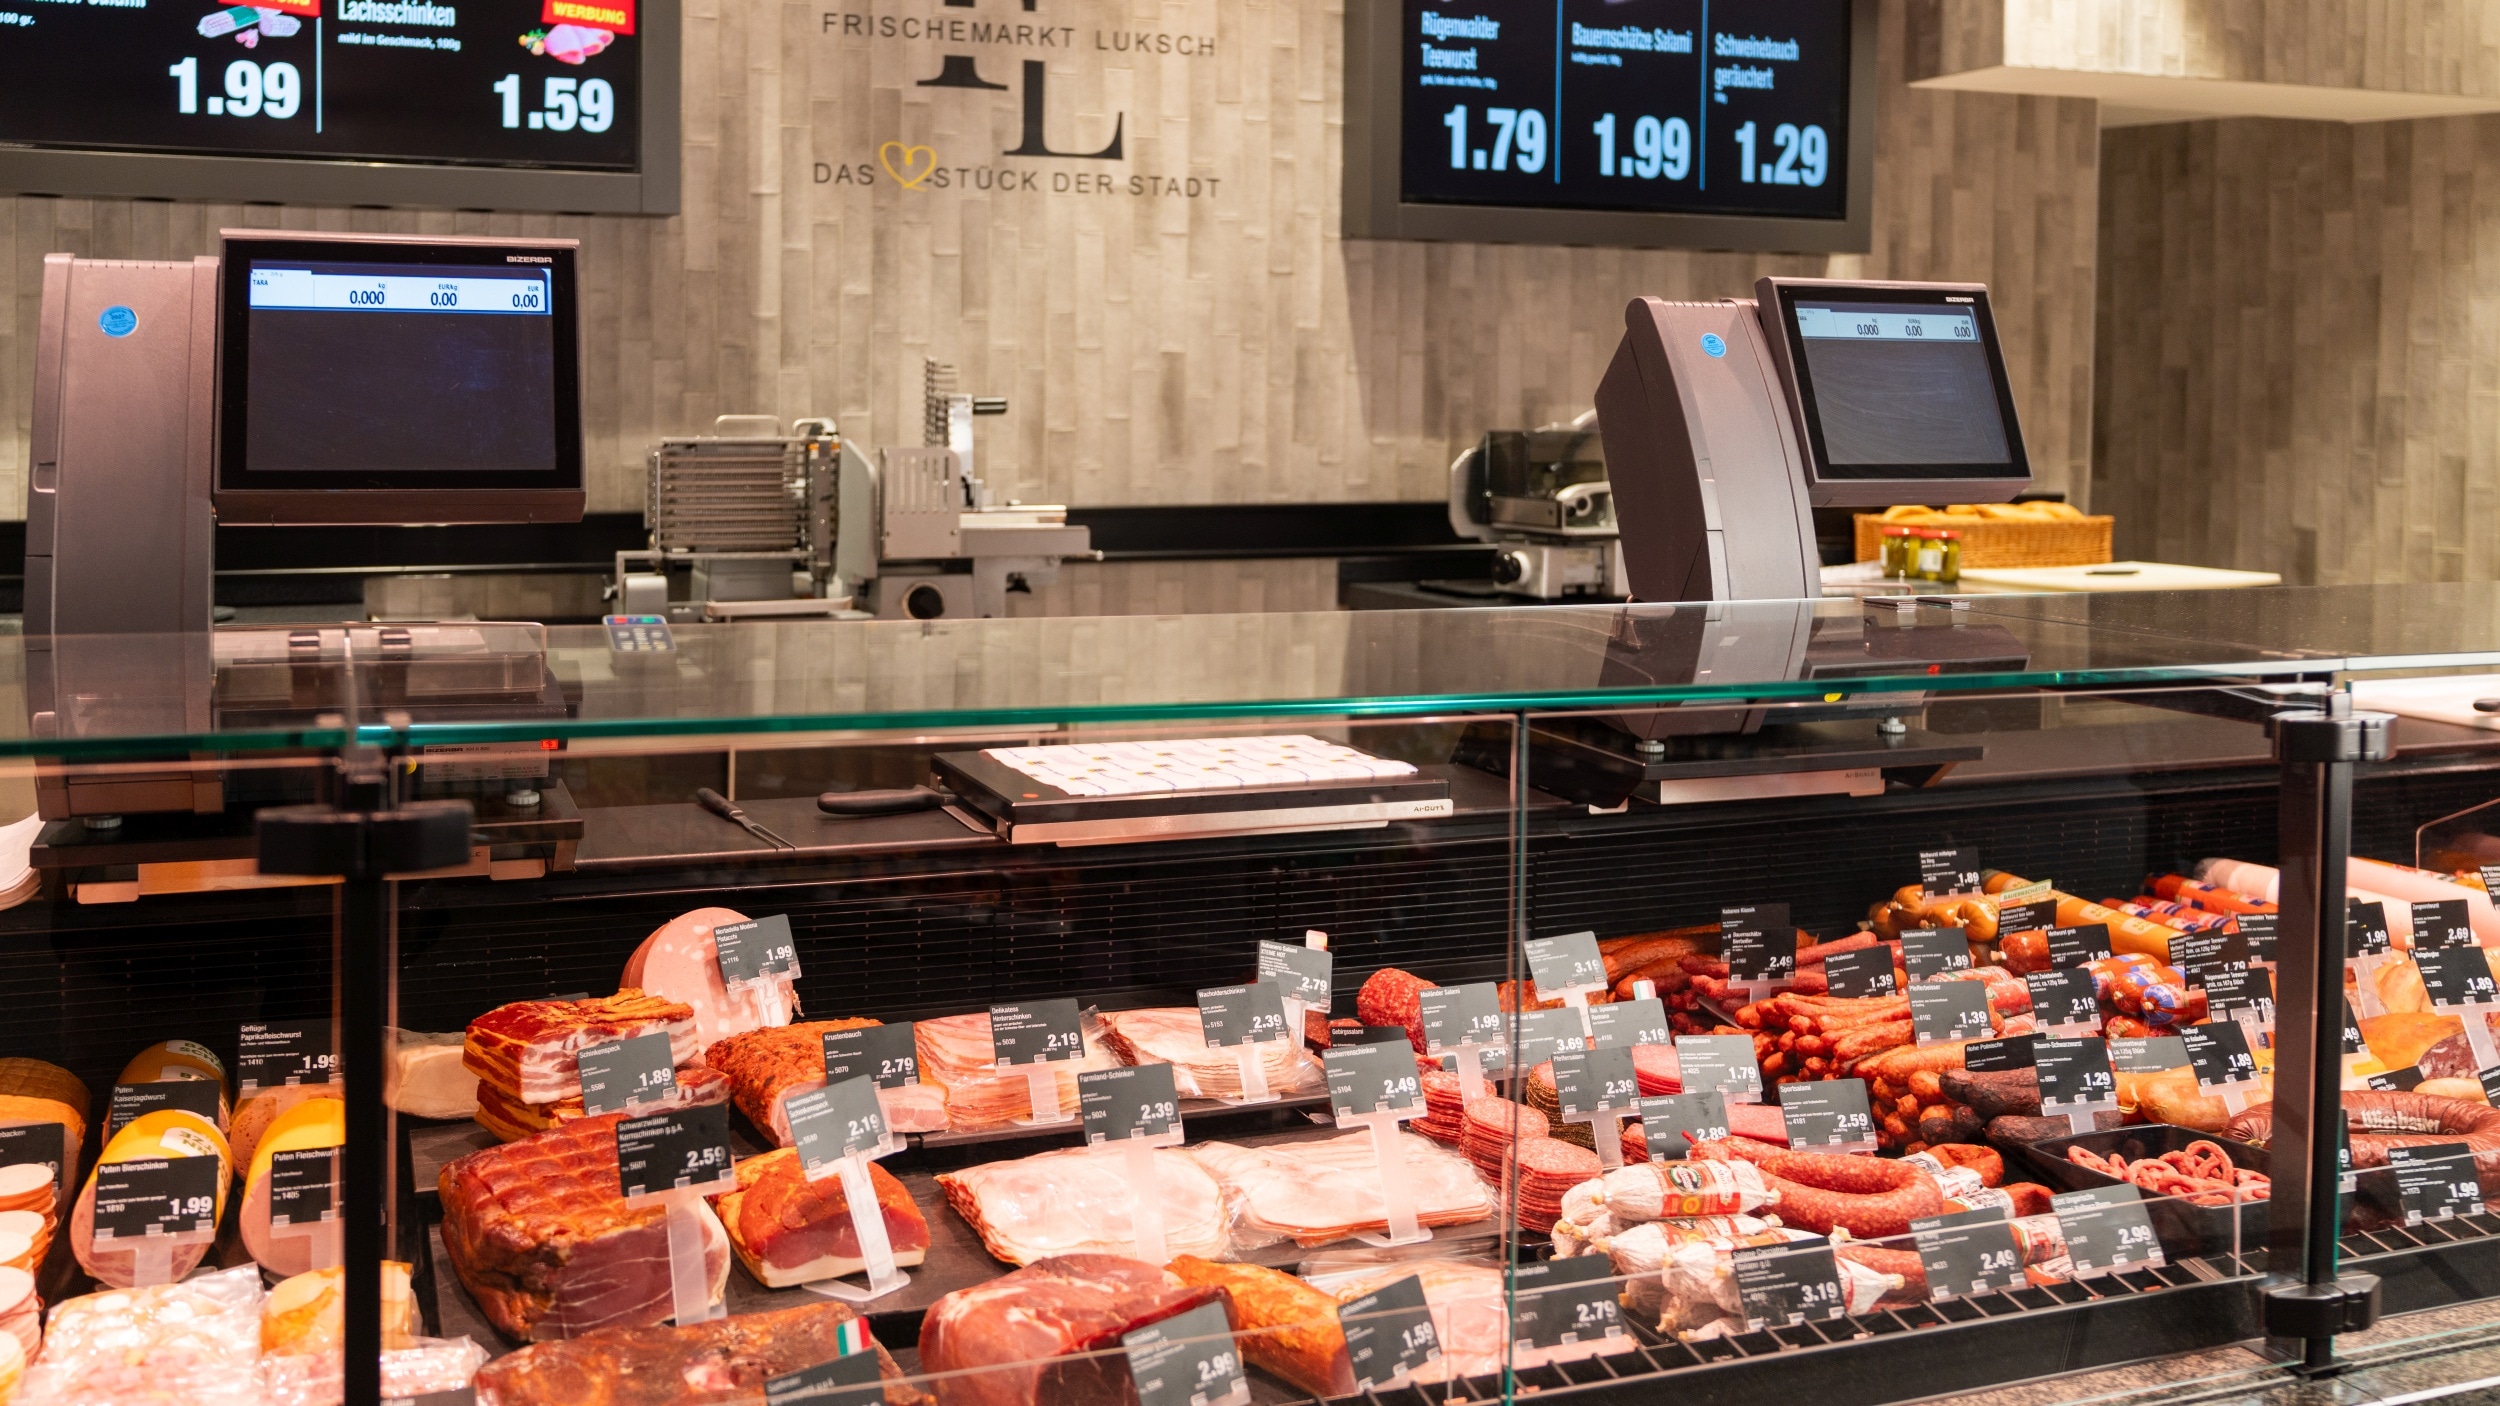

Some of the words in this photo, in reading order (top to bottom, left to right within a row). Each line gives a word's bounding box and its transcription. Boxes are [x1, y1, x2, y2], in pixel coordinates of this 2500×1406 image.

[553, 2, 627, 24] WERBUNG
[362, 35, 376, 45] im
[822, 12, 1076, 48] FRISCHEMARKT
[1095, 29, 1216, 56] LUKSCH
[1571, 22, 1653, 51] Bauernschätze
[1653, 27, 1693, 54] Salami
[1714, 33, 1800, 61] Schweinebauch
[1421, 43, 1478, 70] Teewurst
[1714, 66, 1774, 90] geräuchert
[169, 56, 301, 119] 1.99
[493, 74, 615, 132] 1.59
[1444, 104, 1547, 174] 1.79
[1593, 113, 1692, 181] 1.99
[1735, 121, 1829, 187] 1.29
[813, 162, 875, 184] DAS
[1053, 171, 1113, 195] DER
[1128, 177, 1221, 198] STADT
[506, 256, 552, 264] BIZERBA
[252, 279, 269, 287] TARA
[527, 285, 540, 293] EUR
[349, 290, 385, 306] 0,000
[430, 291, 458, 308] 0,00
[512, 293, 539, 310] 0,00
[1857, 323, 1880, 337] 0,000
[1905, 325, 1923, 338] 0,00
[1954, 326, 1972, 339] 0,00
[1958, 872, 1979, 883] 1.89
[715, 926, 739, 935] Mortadella
[740, 923, 757, 931] Modena
[2366, 930, 2387, 943] 1.99
[2448, 927, 2469, 940] 2.69
[766, 945, 792, 961] 1.99
[1575, 959, 1600, 973] 3.19
[1770, 956, 1793, 967] 2.49
[1945, 955, 1969, 967] 1.89
[1302, 977, 1327, 991] 2.79
[1870, 974, 1893, 988] 1.39
[2467, 977, 2494, 991] 1.89
[2072, 997, 2095, 1010] 2.19
[2249, 997, 2272, 1010] 1.79
[993, 1013, 1032, 1022] Hinterschinken
[1253, 1014, 1282, 1028] 2.39
[1472, 1014, 1499, 1029] 1.99
[1960, 1011, 1987, 1024] 1.39
[241, 1025, 267, 1033] Geflügel
[241, 1031, 302, 1041] Paprikafleischwurst
[825, 1030, 862, 1041] Krustenbauch
[1639, 1028, 1665, 1042] 3.19
[1047, 1032, 1078, 1047] 2.19
[1557, 1037, 1583, 1051] 3.69
[580, 1044, 621, 1058] Schinkenspeck
[302, 1054, 338, 1069] 1.99
[882, 1057, 914, 1074] 2.79
[2229, 1053, 2252, 1068] 1.89
[639, 1068, 671, 1087] 1.89
[1080, 1070, 1135, 1082] Farmland-Schinken
[1729, 1067, 1756, 1079] 1.79
[2083, 1072, 2111, 1086] 1.29
[1384, 1076, 1416, 1094] 2.49
[1606, 1079, 1634, 1094] 2.39
[1780, 1084, 1811, 1093] Sportsalami
[114, 1093, 165, 1103] Kaiserjagdwurst
[1141, 1102, 1174, 1120] 2.39
[619, 1116, 669, 1131] Schwarzwälder
[848, 1114, 880, 1136] 2.19
[1838, 1113, 1868, 1128] 2.59
[1697, 1126, 1726, 1141] 2.89
[687, 1146, 726, 1167] 2.59
[99, 1166, 121, 1174] Puten
[122, 1162, 169, 1172] Bierschinken
[2448, 1182, 2478, 1198] 1.99
[170, 1196, 213, 1215] 1.99
[2118, 1225, 2152, 1244] 2.99
[1980, 1249, 2016, 1270] 2.49
[1801, 1281, 1838, 1302] 3.19
[1577, 1300, 1616, 1322] 2.79
[1402, 1321, 1434, 1349] 1.59
[1197, 1351, 1235, 1381] 2.99
